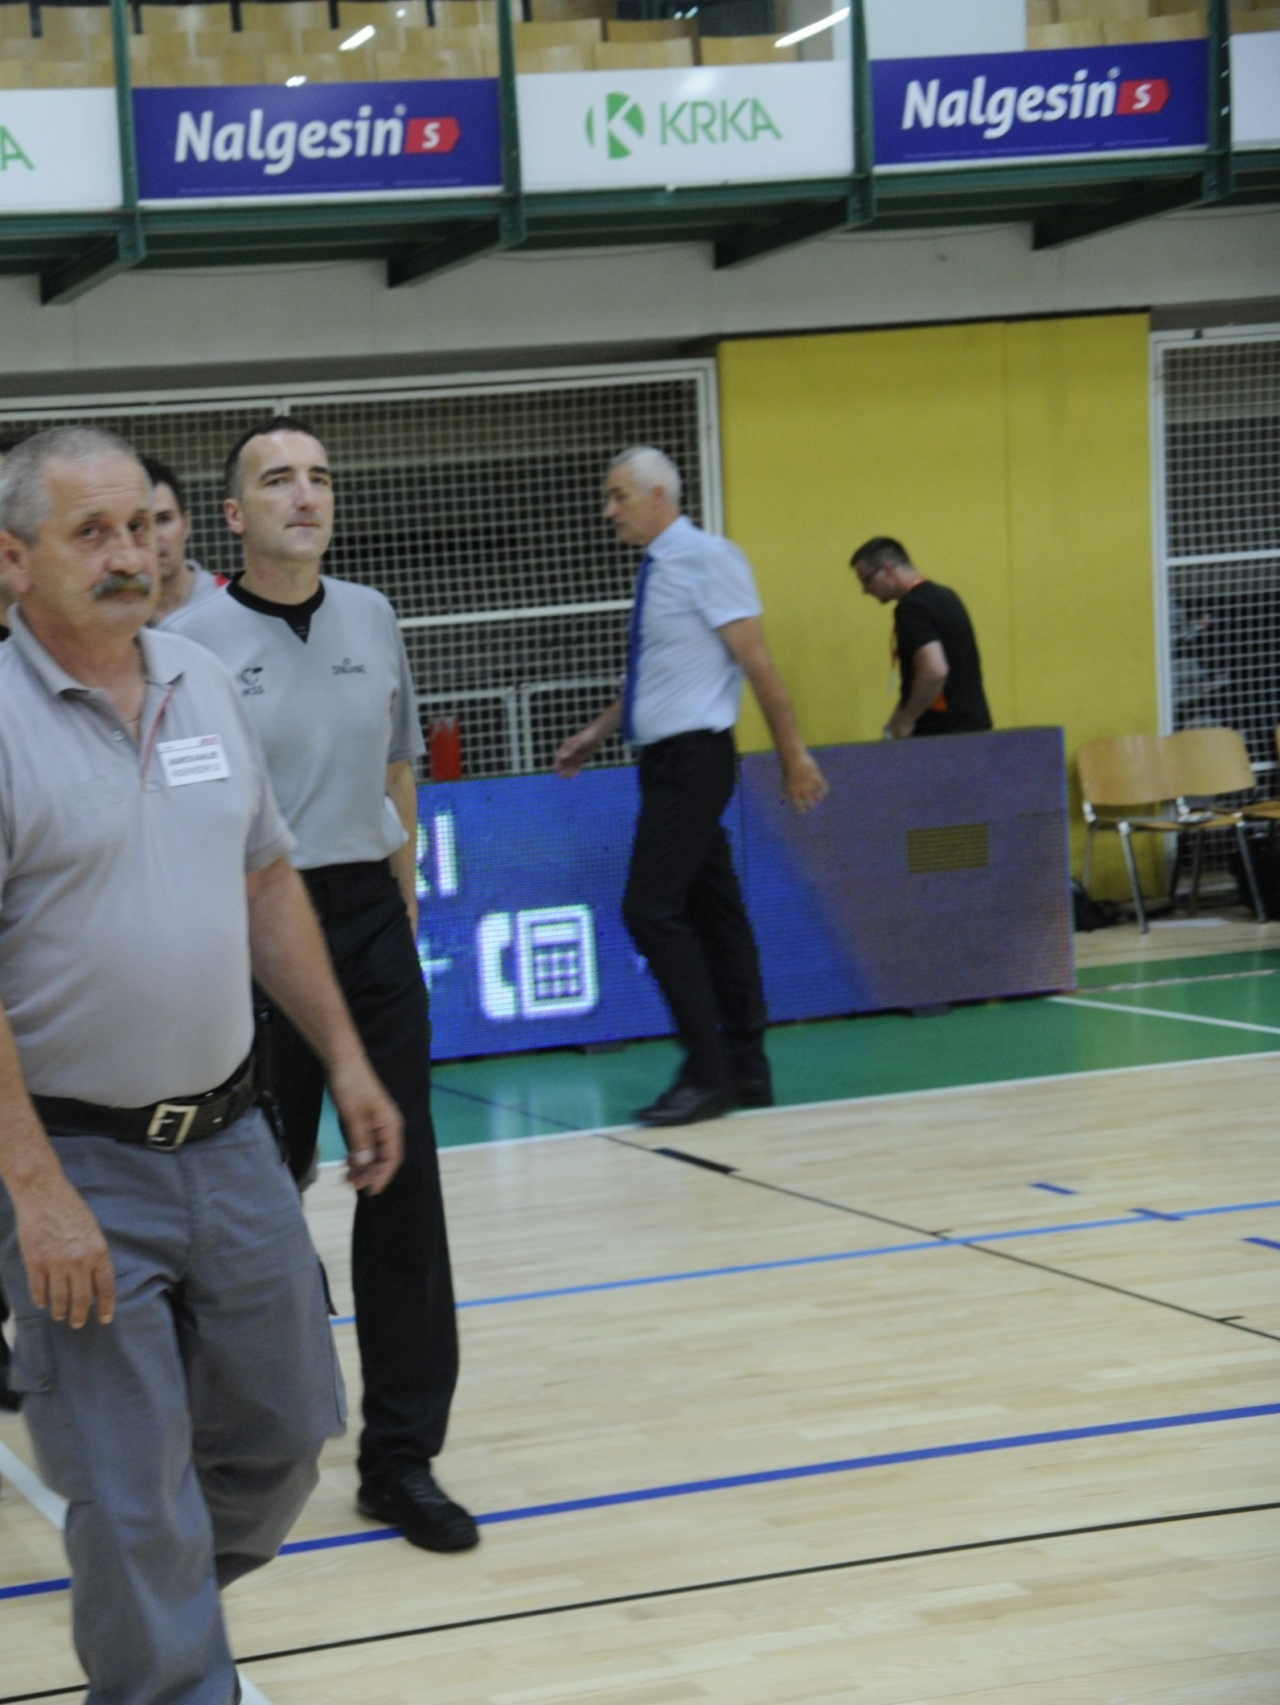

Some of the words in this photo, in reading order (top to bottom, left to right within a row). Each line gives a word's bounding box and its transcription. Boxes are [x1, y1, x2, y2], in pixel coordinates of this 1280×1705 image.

[660, 98, 783, 146] KRKA
[901, 68, 1119, 139] Nalgesin
[174, 104, 407, 175] Nalgesin
